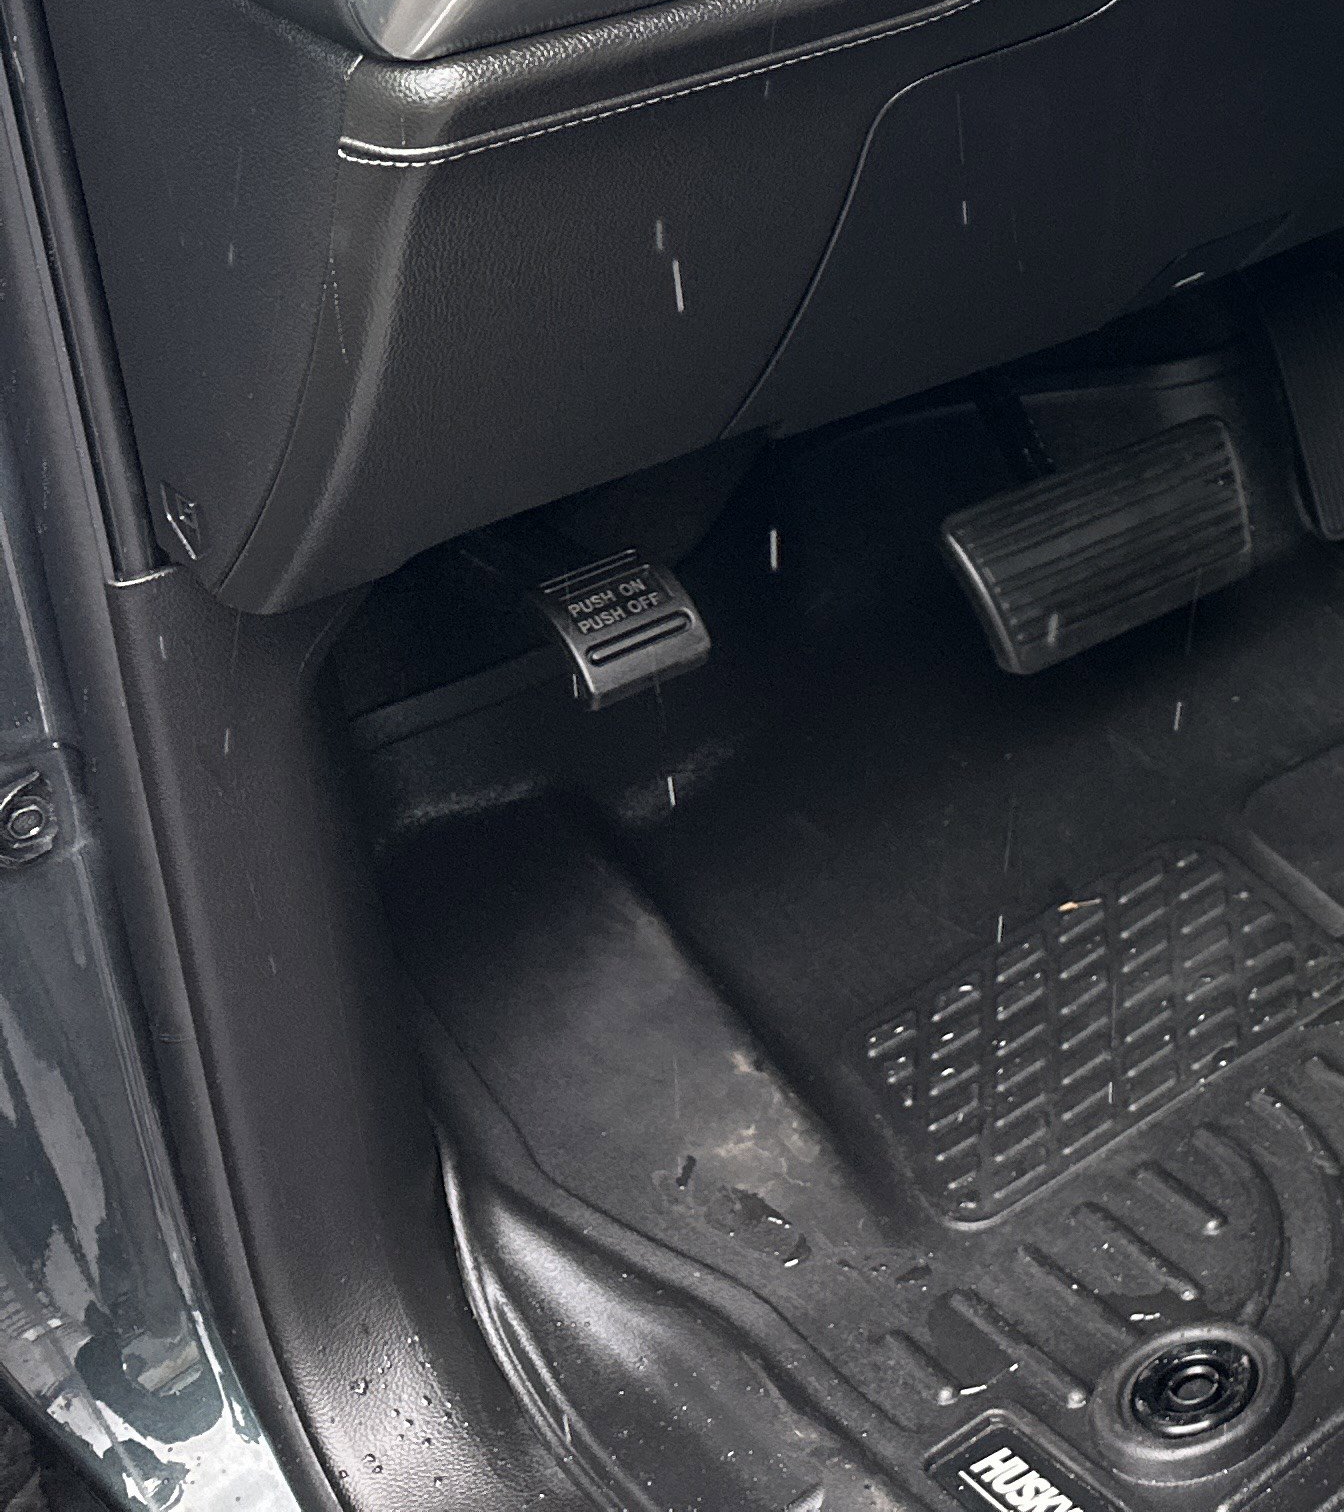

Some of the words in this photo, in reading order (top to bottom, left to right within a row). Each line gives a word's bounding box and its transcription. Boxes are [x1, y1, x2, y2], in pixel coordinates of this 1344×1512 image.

[568, 590, 617, 618] PUSH
[618, 578, 646, 597] ON
[577, 606, 626, 635] PUSH
[627, 591, 659, 613] OFF
[969, 1446, 1084, 1512] HUSK
